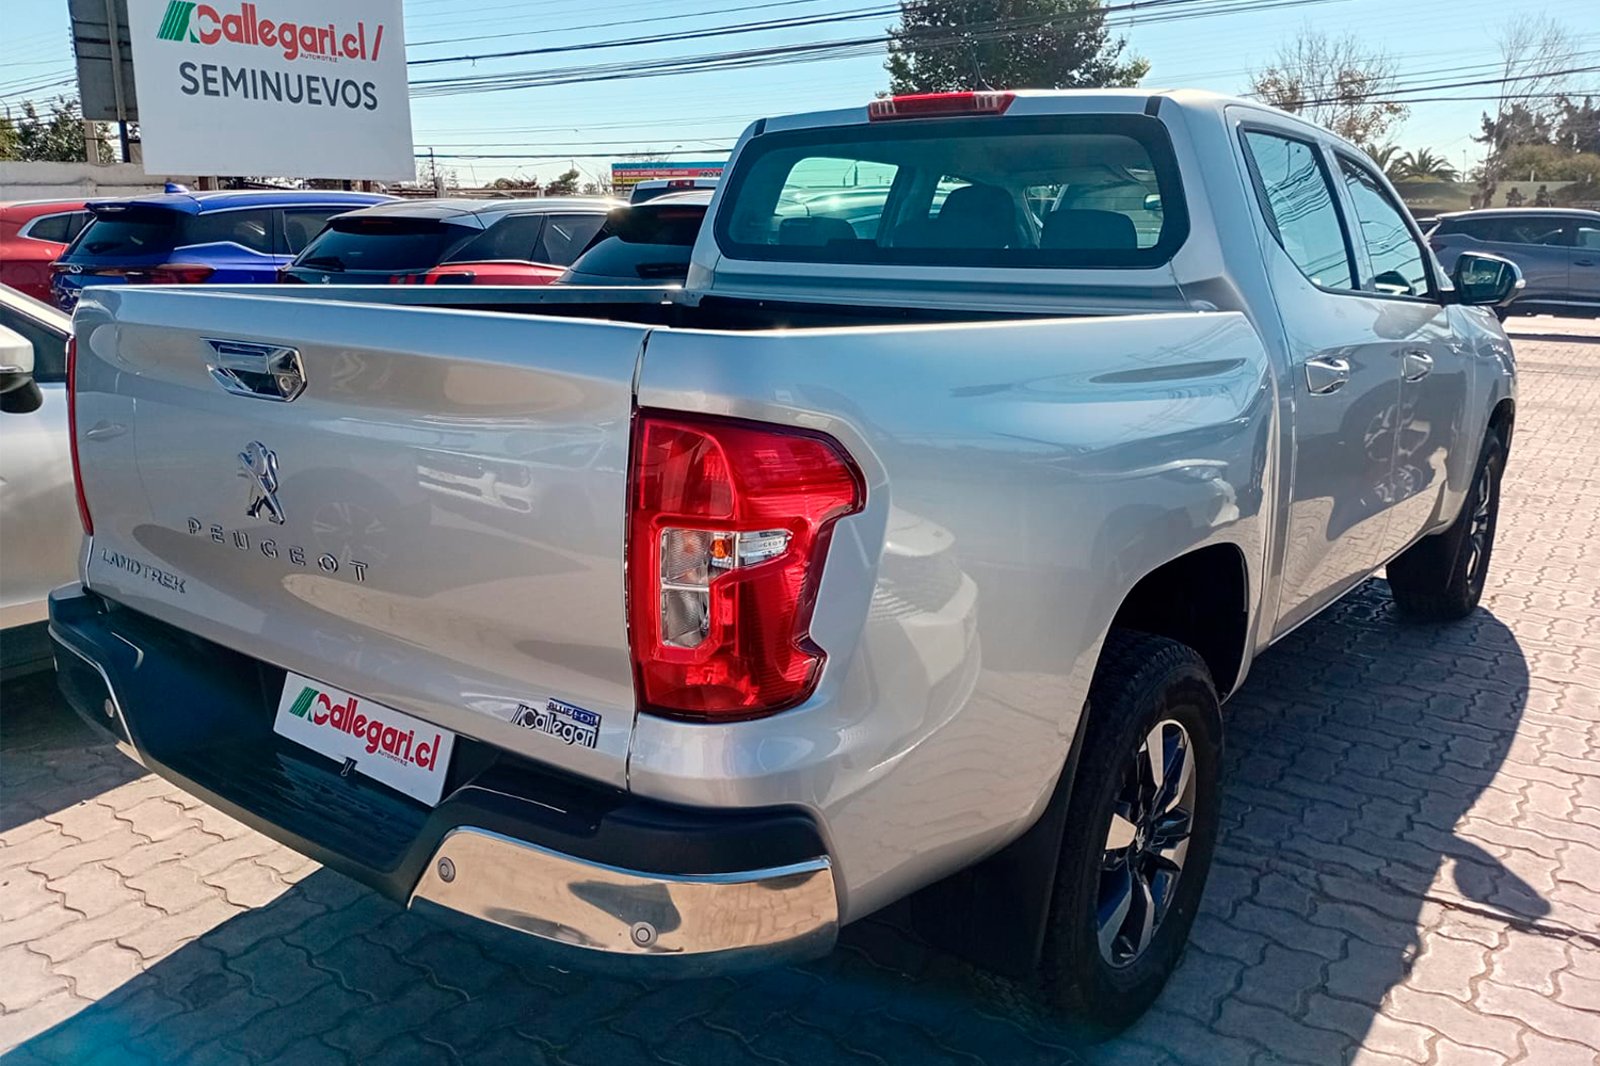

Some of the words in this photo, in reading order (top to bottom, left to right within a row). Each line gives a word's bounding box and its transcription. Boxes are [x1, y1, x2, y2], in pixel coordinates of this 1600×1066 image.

[179, 61, 378, 111] SEMINUEVOS
[102, 547, 186, 594] LANDTREK
[188, 517, 368, 582] PEUGEOT
[312, 693, 441, 772] Callegari.cl
